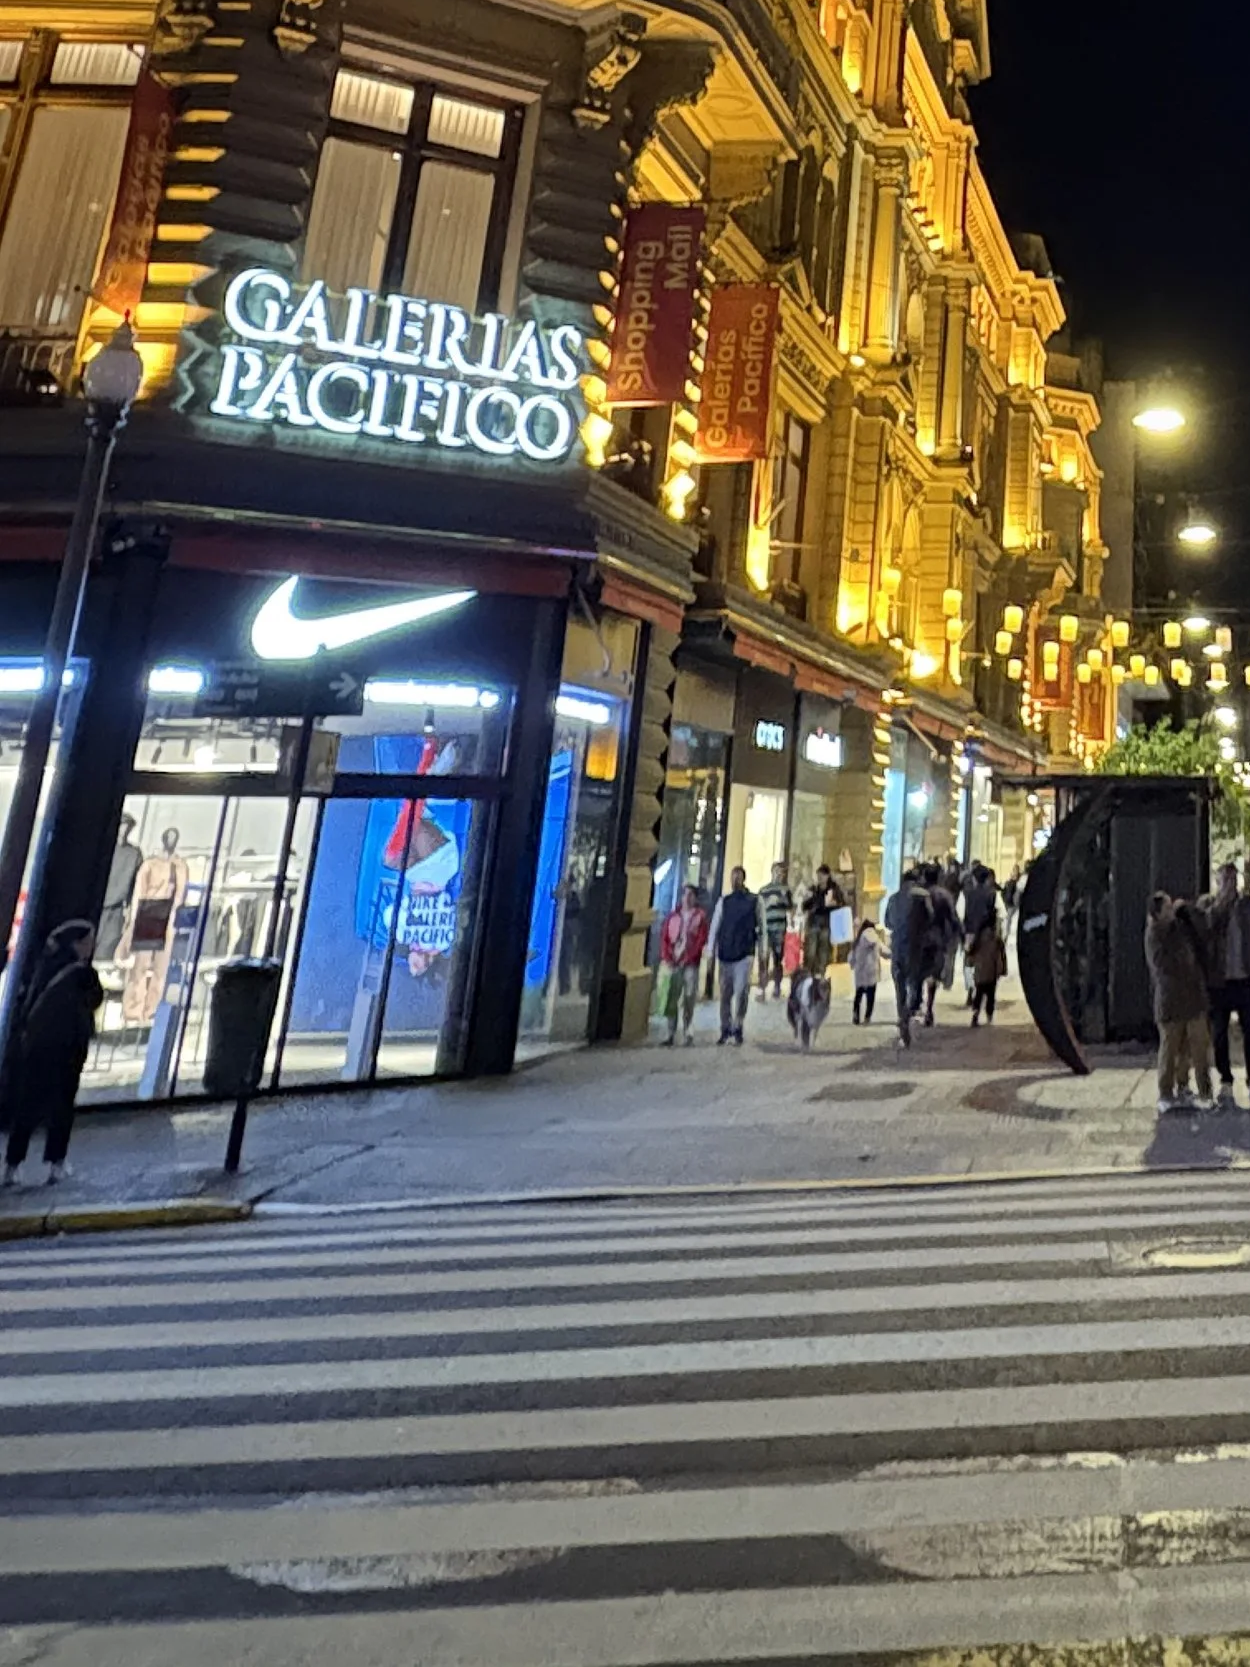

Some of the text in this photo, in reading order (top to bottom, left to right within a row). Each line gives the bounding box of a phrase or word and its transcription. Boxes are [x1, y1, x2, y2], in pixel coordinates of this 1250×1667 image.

[616, 239, 665, 392] Shopping
[664, 225, 694, 290] Mall
[224, 267, 582, 389] GALERIAS
[209, 344, 573, 460] PACIFICO
